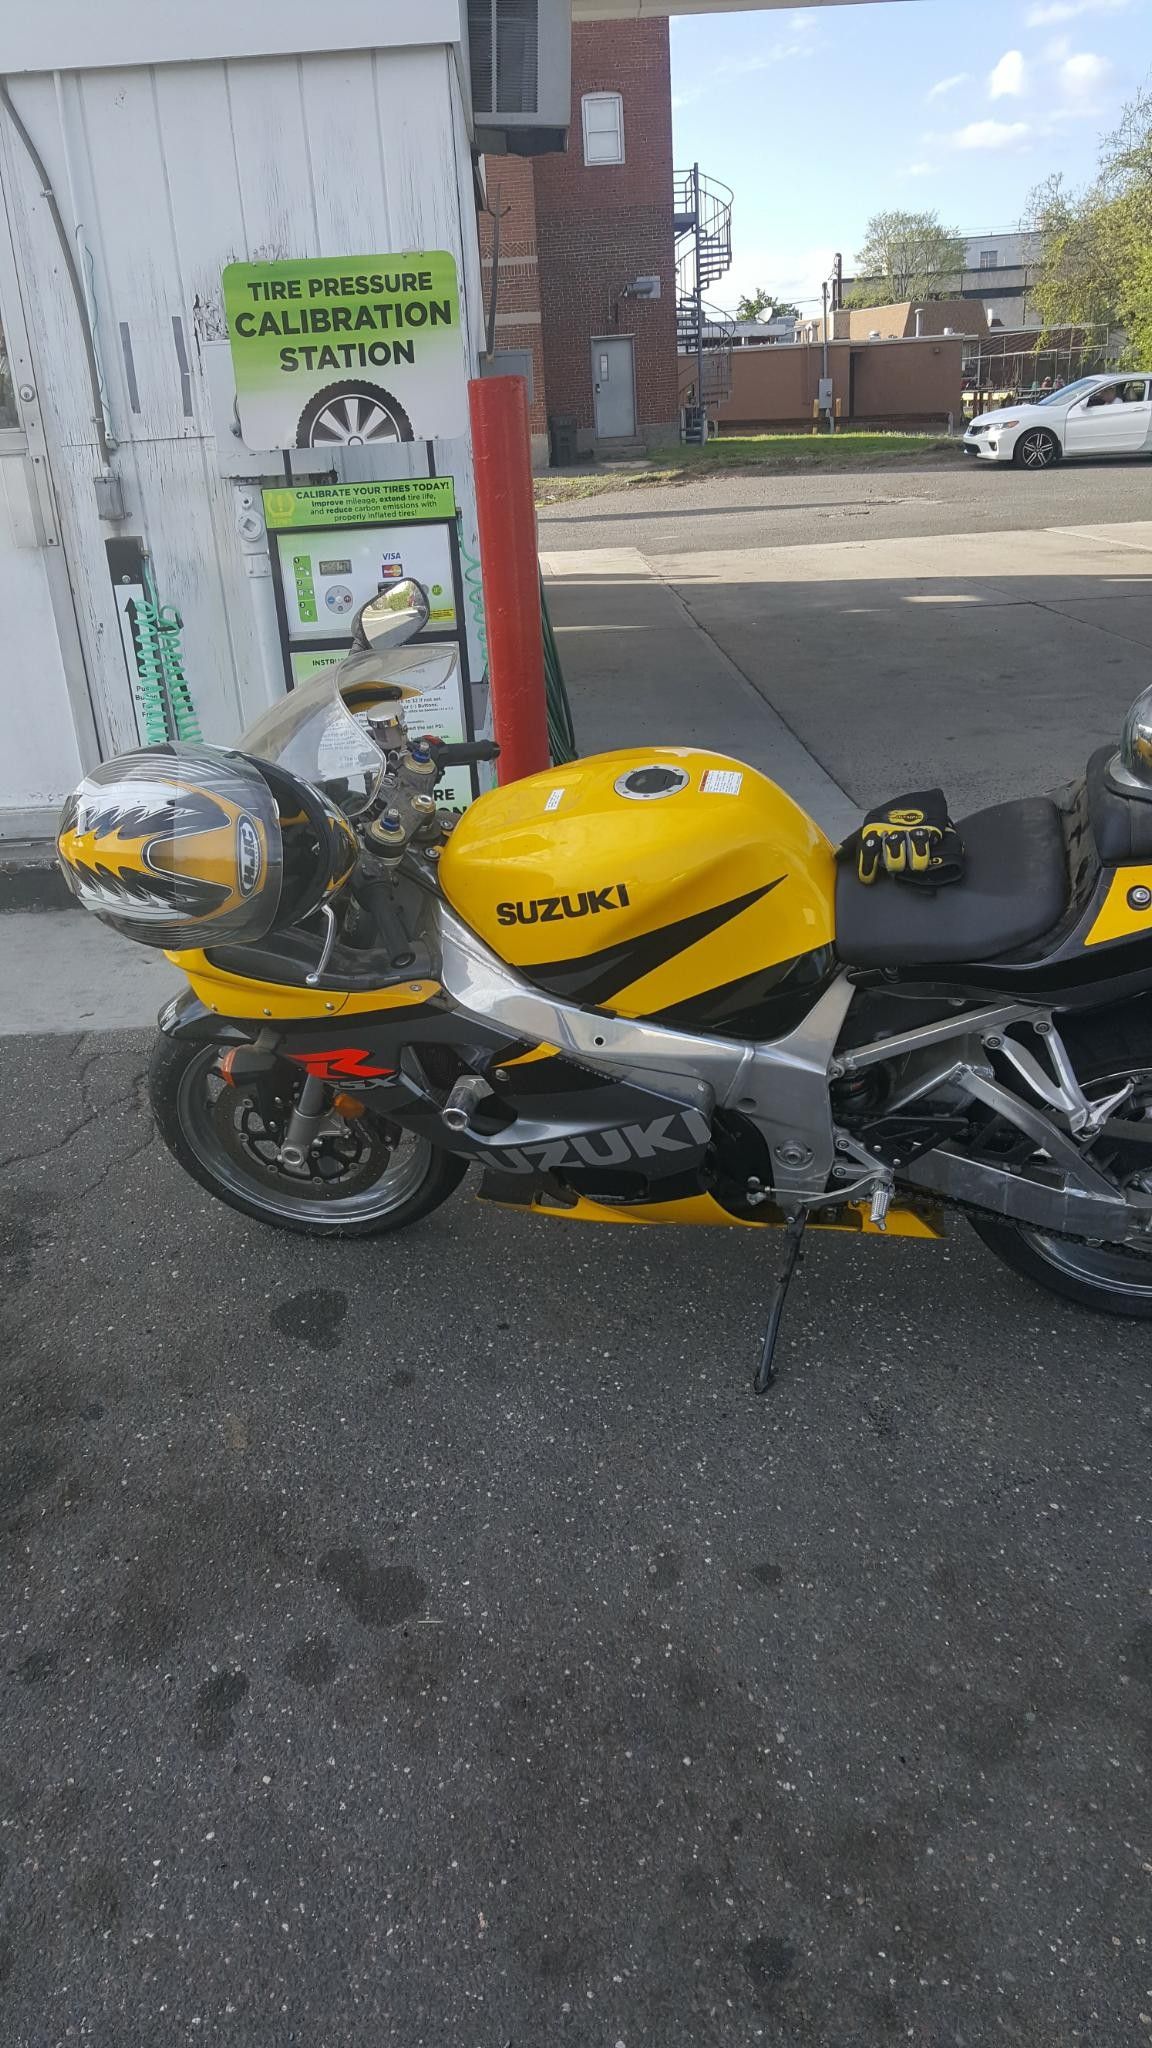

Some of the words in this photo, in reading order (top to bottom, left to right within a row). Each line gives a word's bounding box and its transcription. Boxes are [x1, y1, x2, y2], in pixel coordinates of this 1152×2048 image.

[247, 280, 303, 302] TIRE
[308, 271, 433, 298] PRESSURE
[234, 299, 452, 338] CALIBRATION
[279, 339, 415, 372] STATION
[296, 488, 351, 499] CALIBRATE
[352, 486, 381, 496] YOUR
[383, 484, 411, 493] TIRES
[412, 481, 450, 492] TODAY!
[310, 507, 325, 515] and
[326, 505, 353, 514] reduce
[354, 503, 381, 512] carbon
[382, 501, 419, 510] emissions
[420, 500, 437, 508] with
[311, 499, 344, 508] Improve
[345, 496, 378, 506] mileage,
[379, 494, 406, 503] extend
[407, 493, 421, 501] tire
[334, 513, 367, 523] properly
[367, 511, 397, 519] inflated
[382, 552, 401, 561] VISA
[433, 788, 455, 801] RE
[496, 883, 630, 927] SUZUKI
[287, 1047, 396, 1079] R
